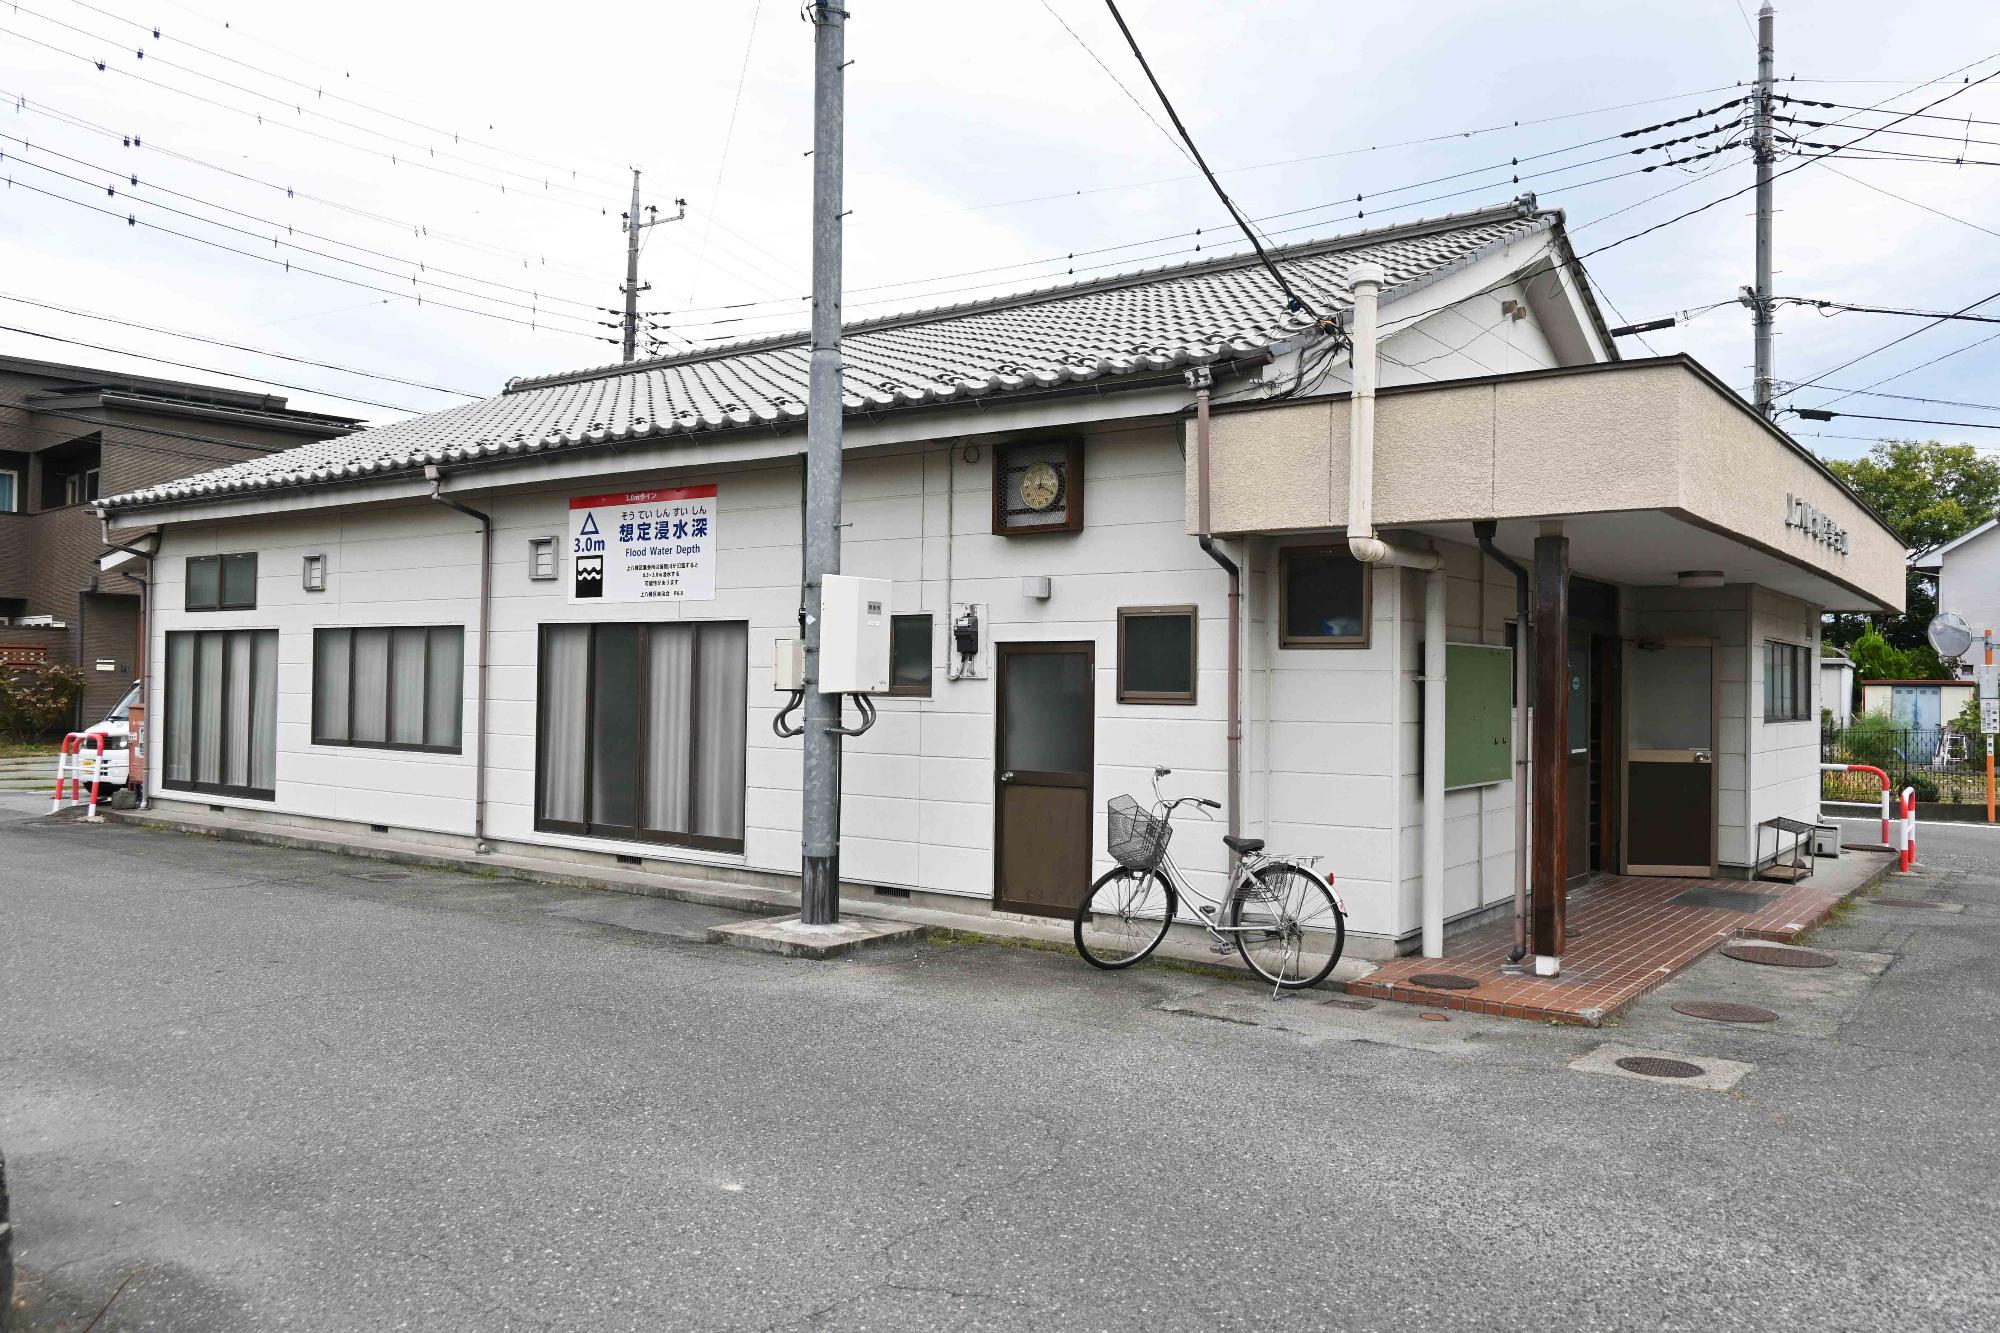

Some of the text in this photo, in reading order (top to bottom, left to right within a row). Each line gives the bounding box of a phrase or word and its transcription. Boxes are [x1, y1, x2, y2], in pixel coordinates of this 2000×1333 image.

[619, 517, 708, 543] 想定浸水深
[573, 537, 606, 553] 3.0m
[625, 544, 701, 557] Flood Water Depth
